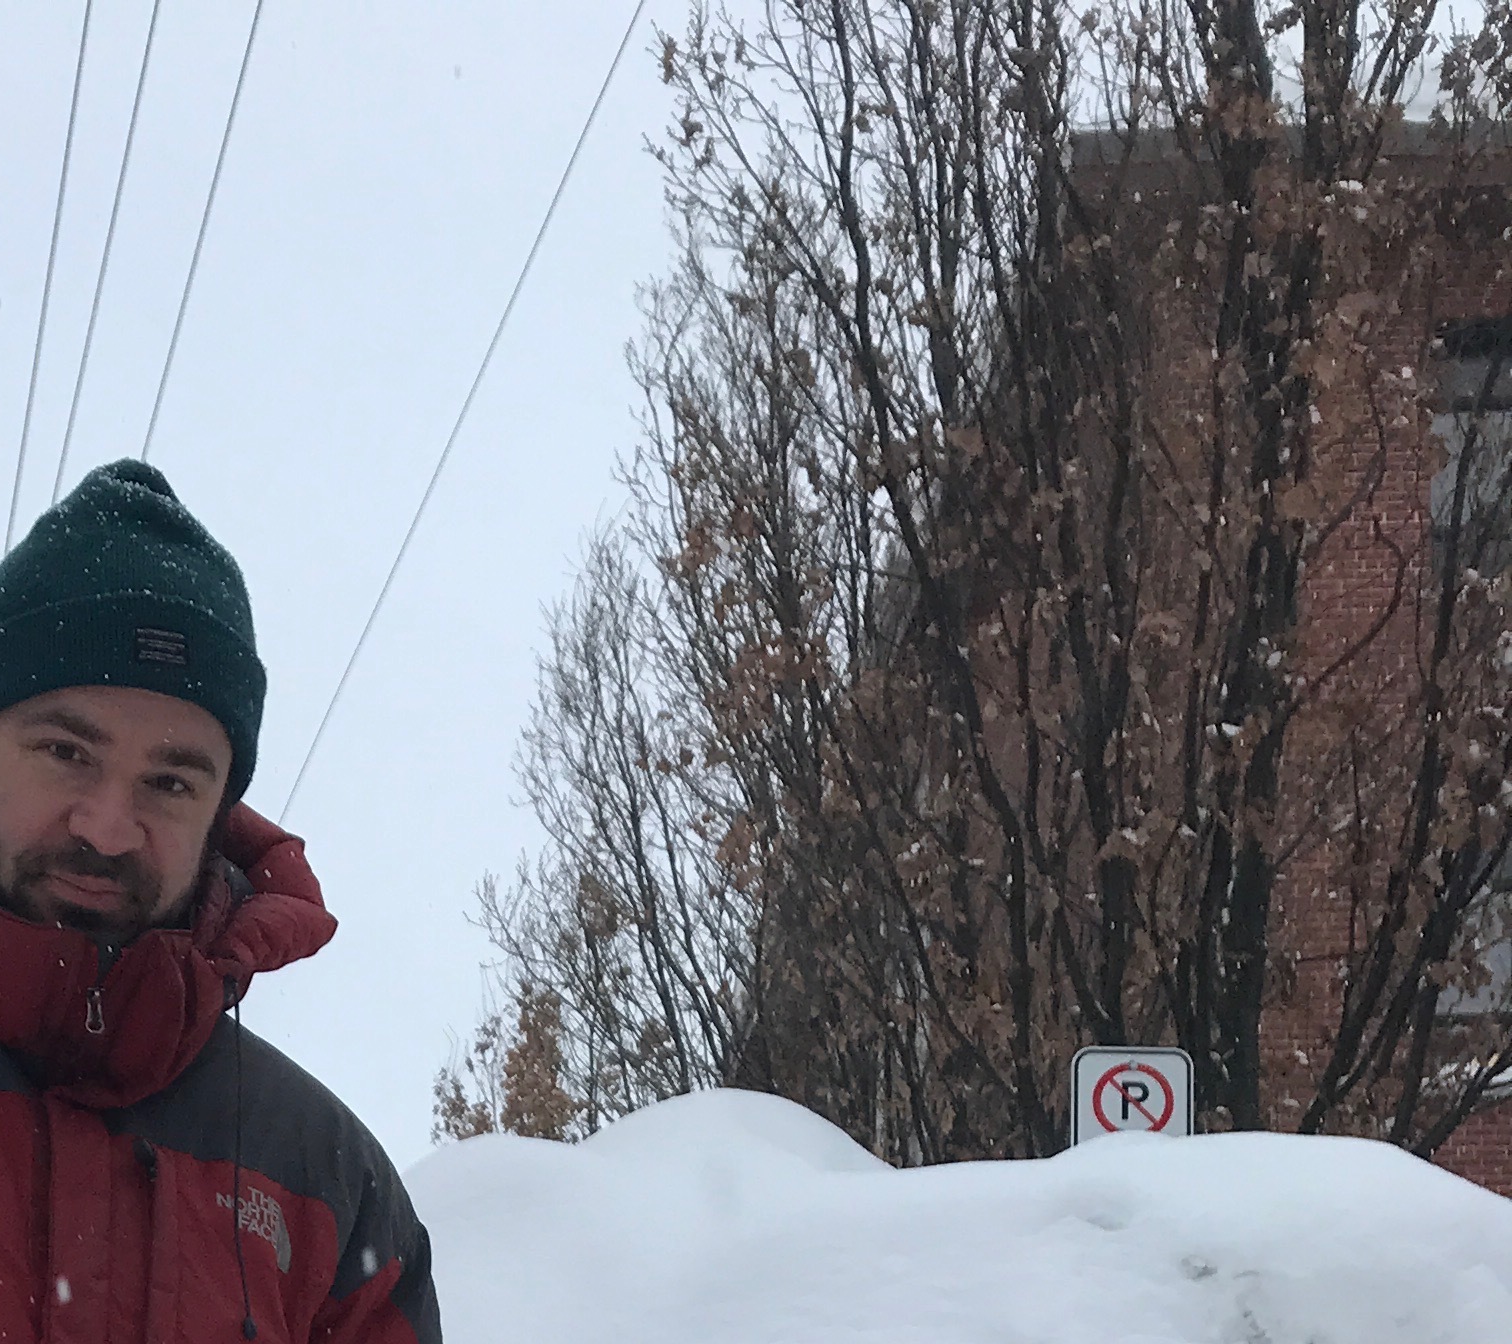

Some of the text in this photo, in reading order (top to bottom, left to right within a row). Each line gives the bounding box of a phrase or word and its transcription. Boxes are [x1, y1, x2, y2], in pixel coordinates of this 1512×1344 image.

[1121, 1080, 1150, 1120] P
[215, 1192, 279, 1232] NORTH
[247, 1186, 281, 1214] THE
